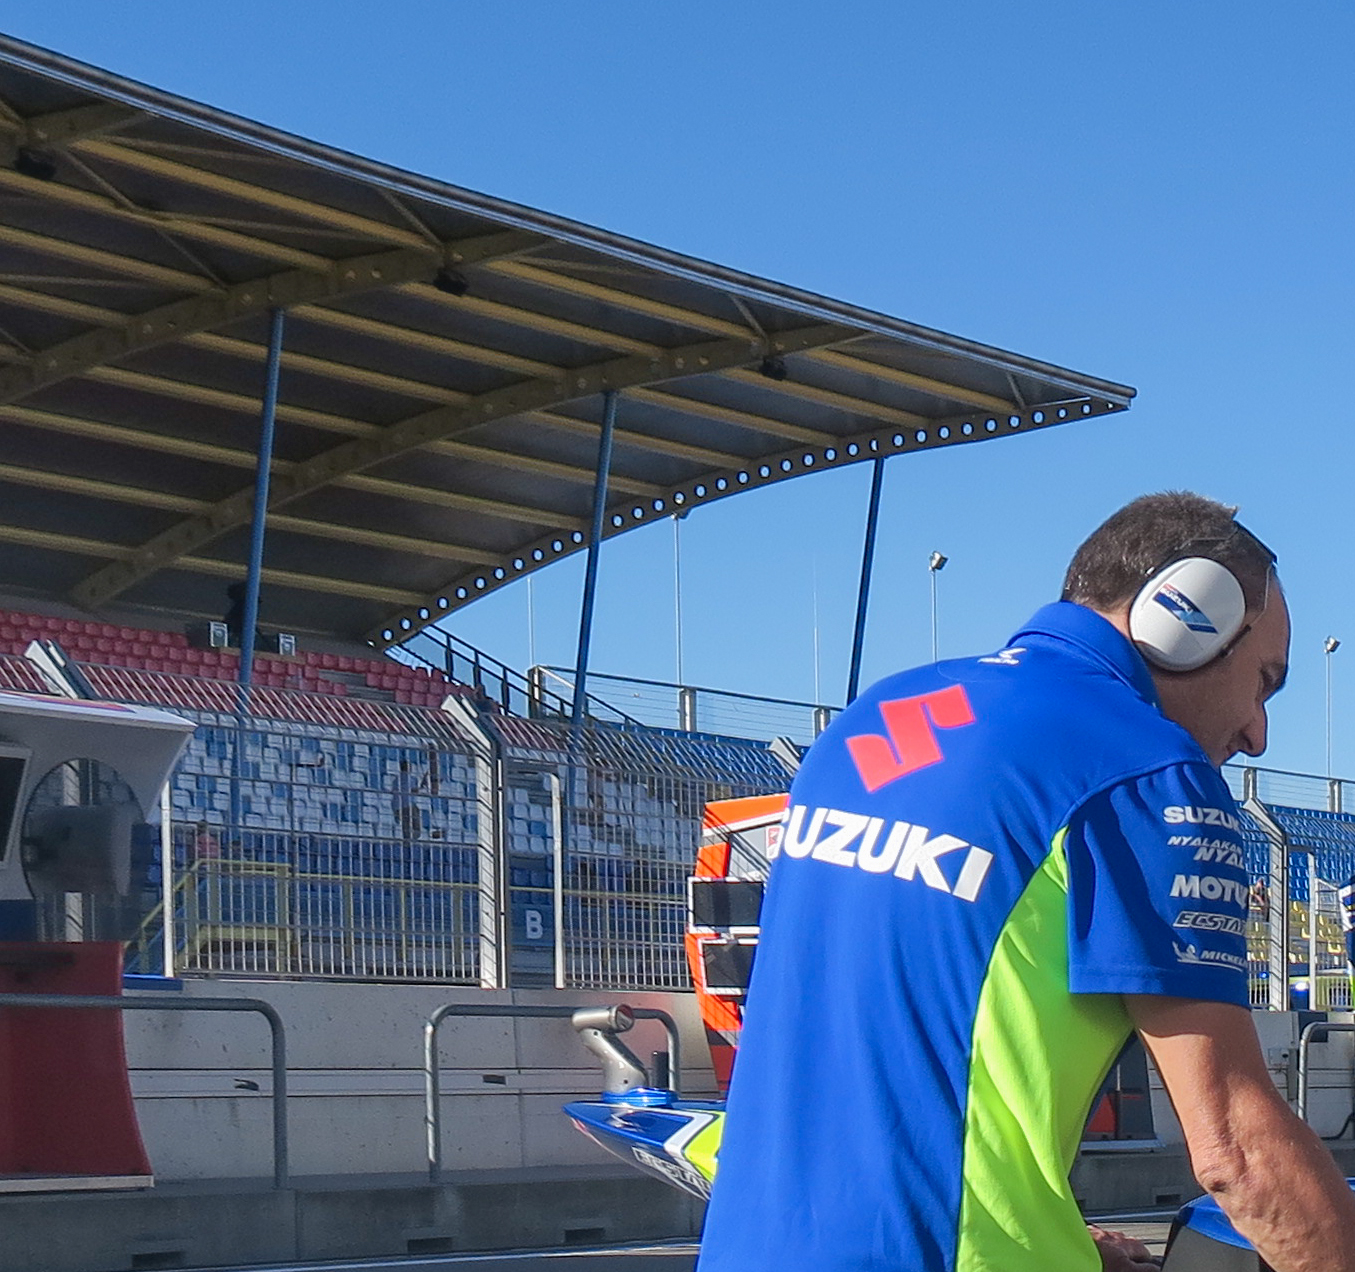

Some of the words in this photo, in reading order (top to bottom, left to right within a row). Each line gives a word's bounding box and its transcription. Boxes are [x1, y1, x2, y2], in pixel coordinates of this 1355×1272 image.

[782, 805, 993, 902] UZUKI
[525, 909, 543, 940] B
[1173, 911, 1246, 936] ECSTA
